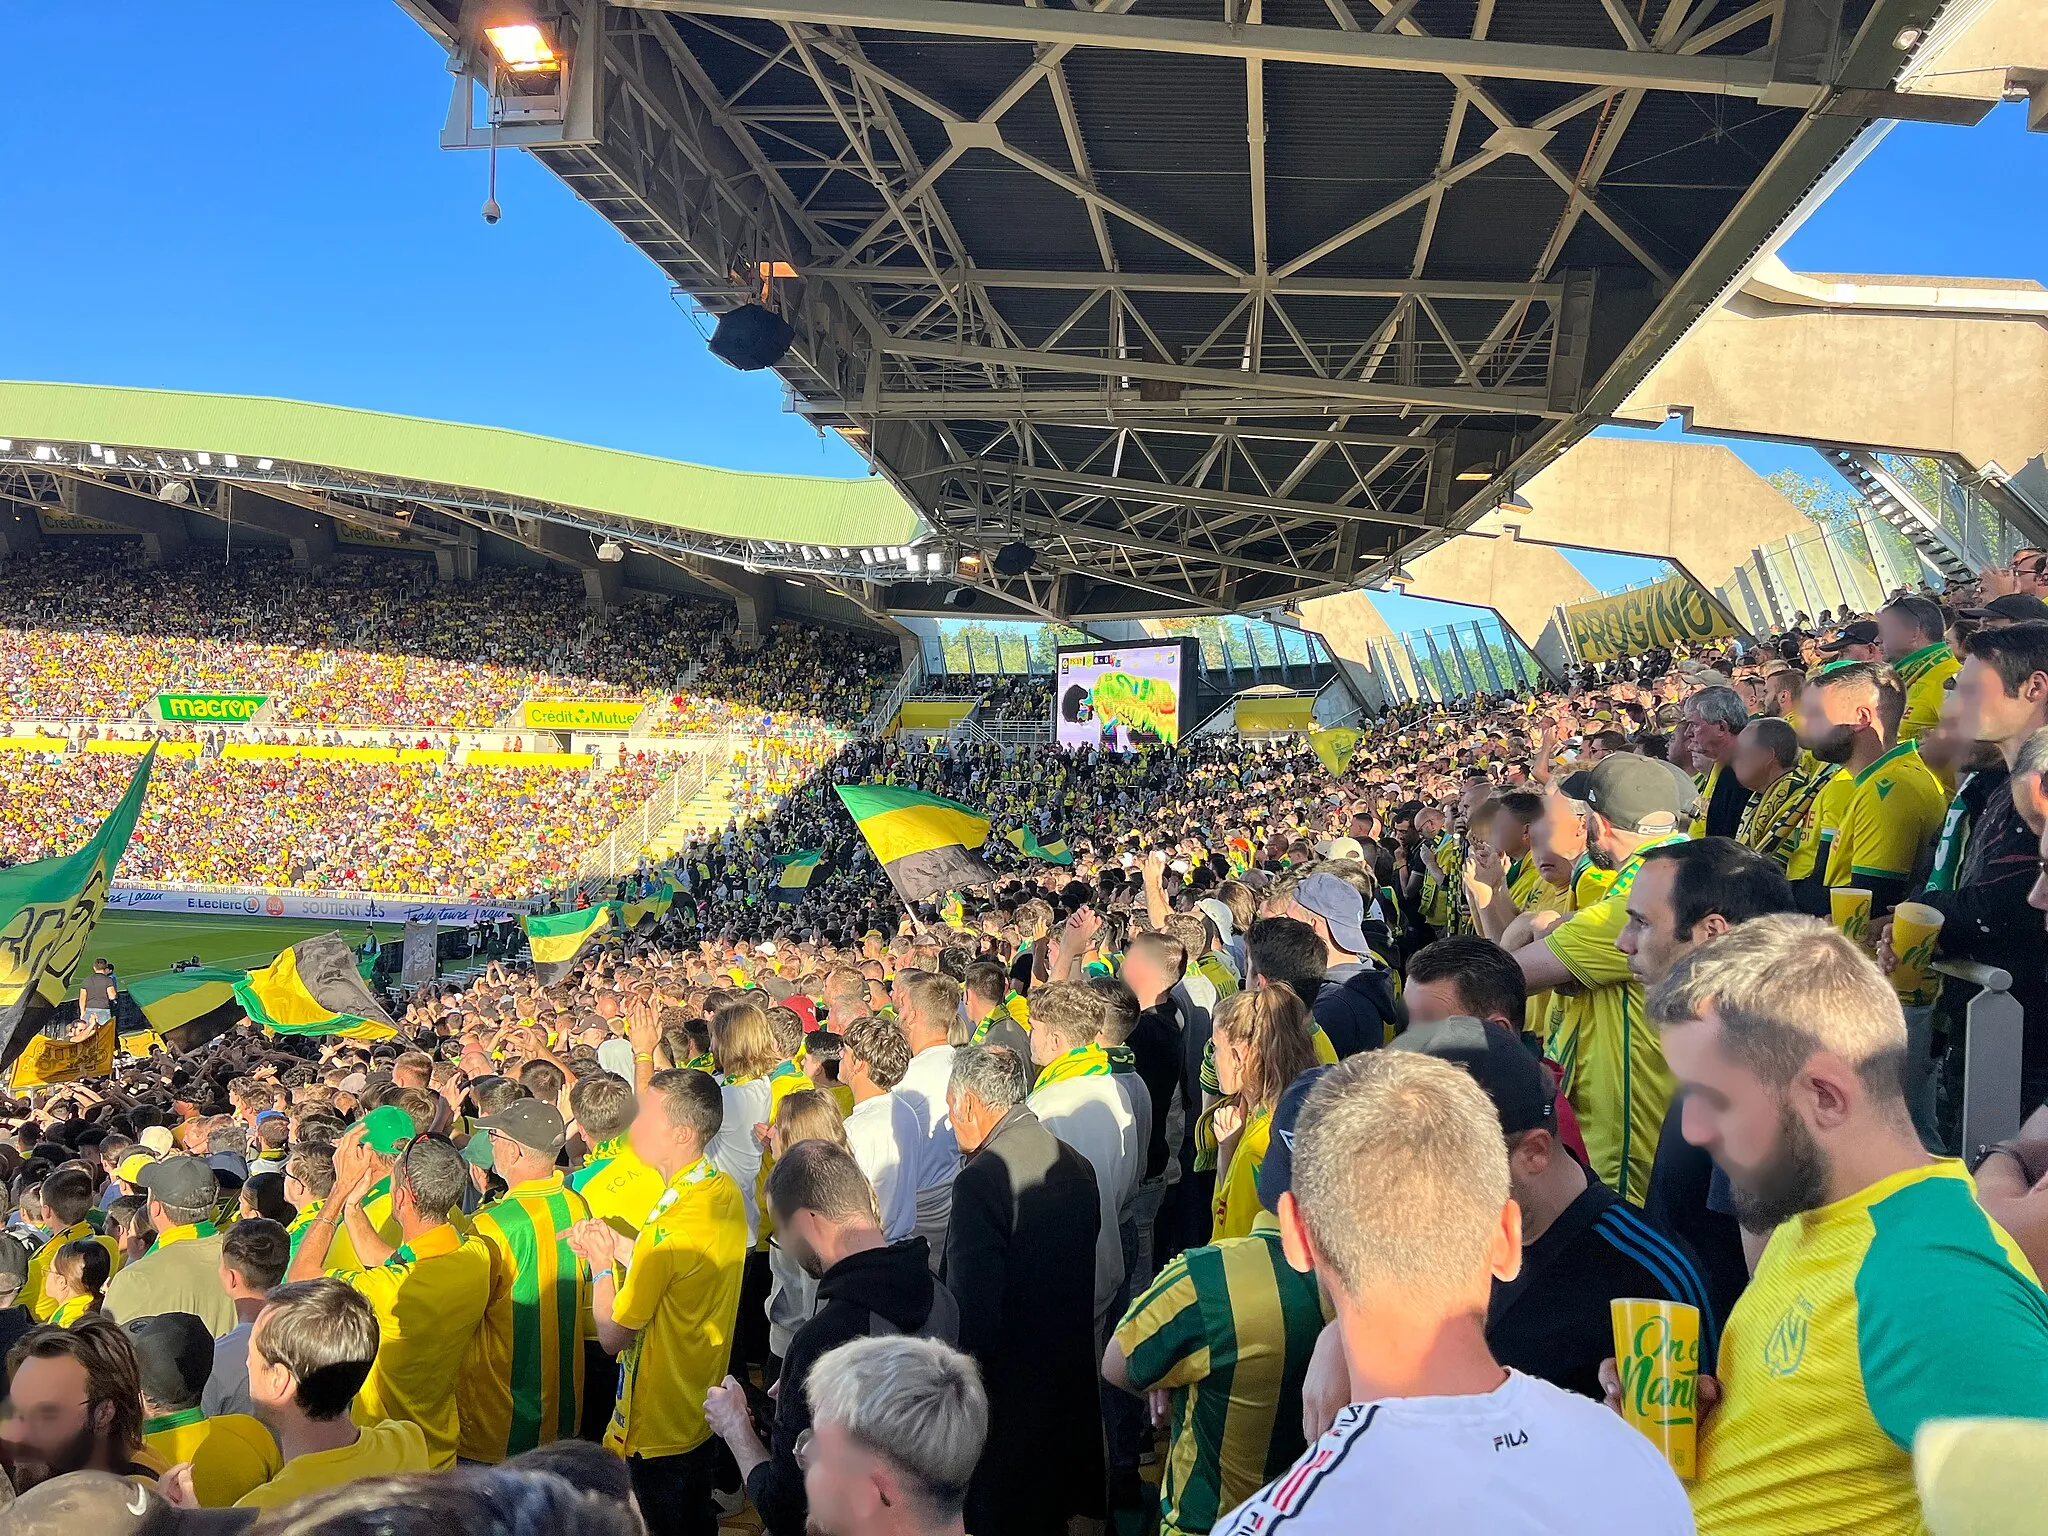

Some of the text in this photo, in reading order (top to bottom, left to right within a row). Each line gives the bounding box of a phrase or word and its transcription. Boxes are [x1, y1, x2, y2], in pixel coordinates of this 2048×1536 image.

[1570, 583, 1732, 657] PROGINO
[169, 698, 258, 717] macron
[531, 708, 638, 724] Crédit Mutue
[187, 898, 242, 910] E.Leclerc
[302, 901, 361, 916] SOUTIENT
[1493, 1429, 1528, 1451] FILA
